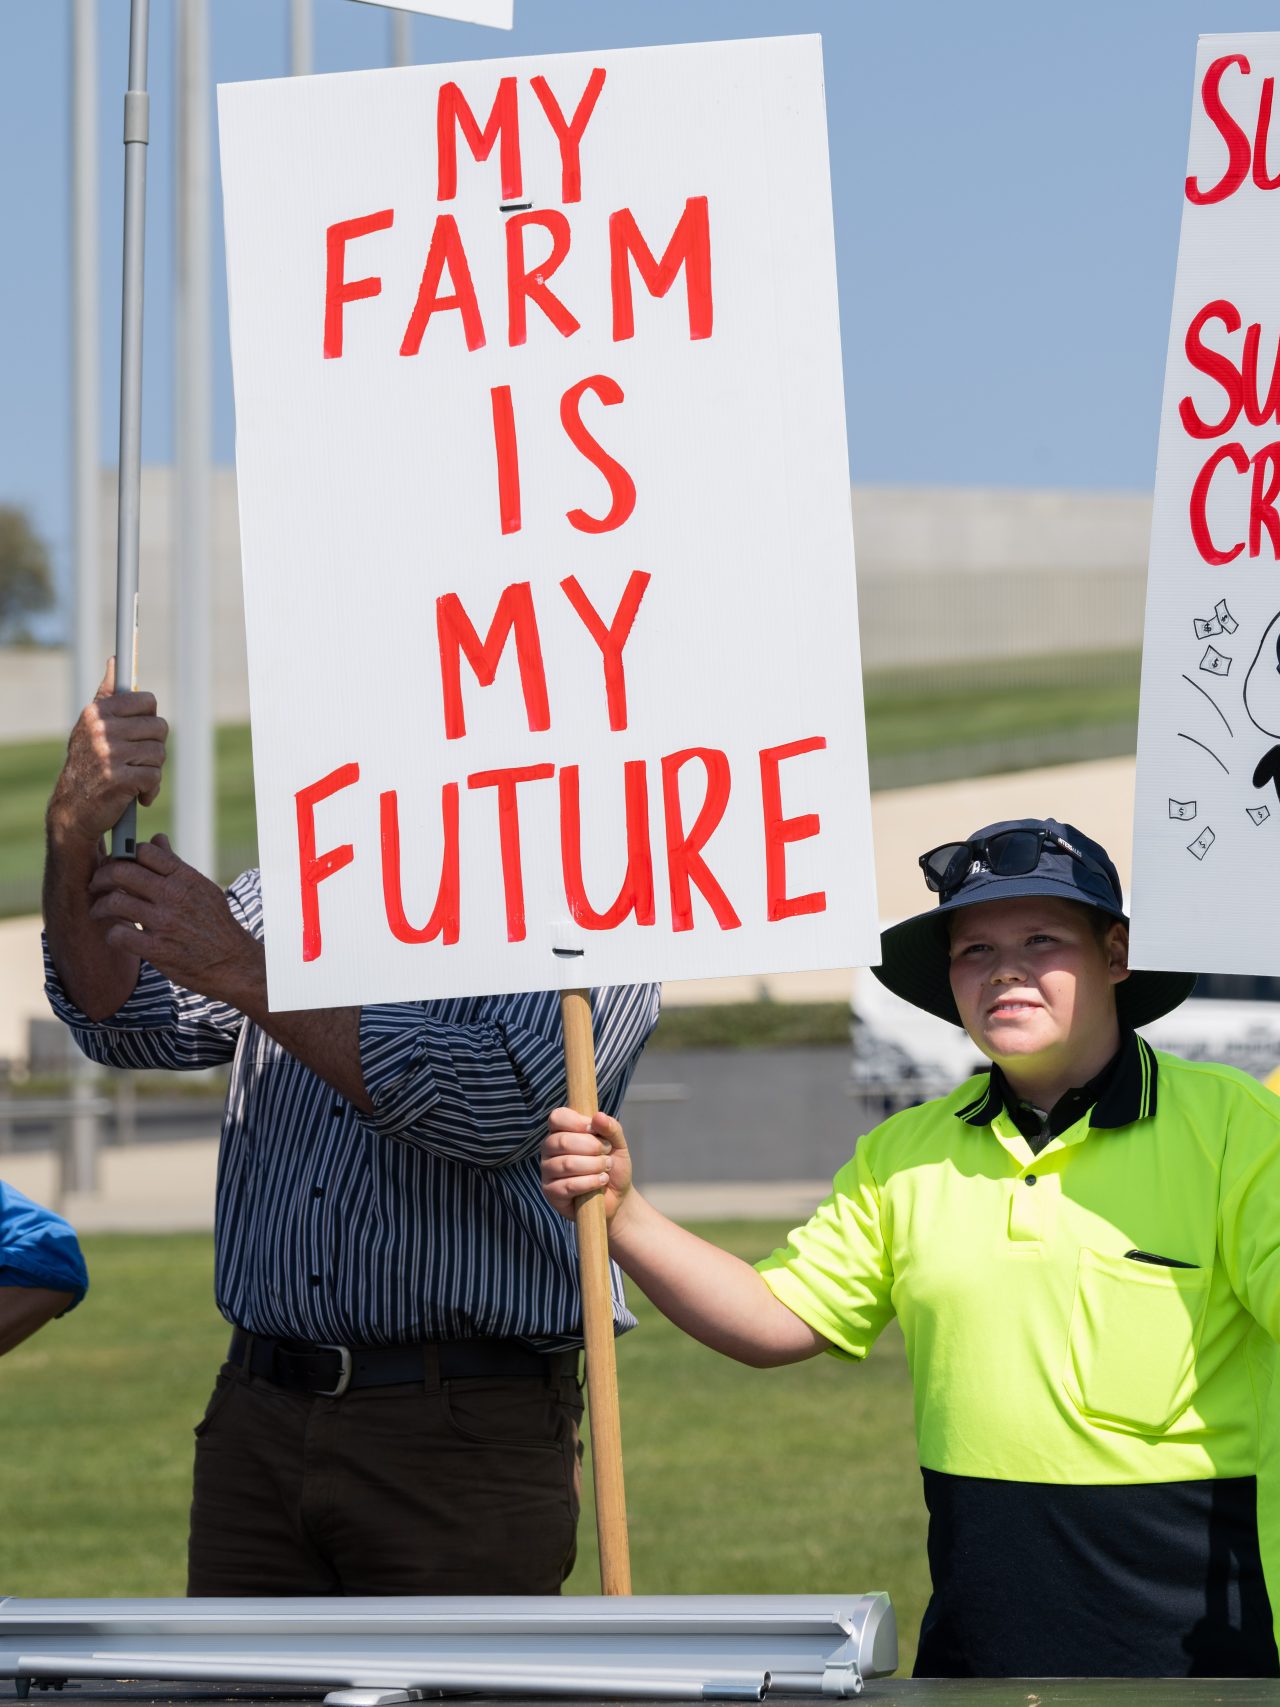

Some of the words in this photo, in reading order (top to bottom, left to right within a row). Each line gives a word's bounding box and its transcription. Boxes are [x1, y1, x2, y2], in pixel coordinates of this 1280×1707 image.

[437, 68, 606, 203] MY
[324, 195, 713, 358] FARM
[491, 375, 636, 535] IS
[436, 571, 651, 740] MY
[295, 737, 826, 962] FUTURE
